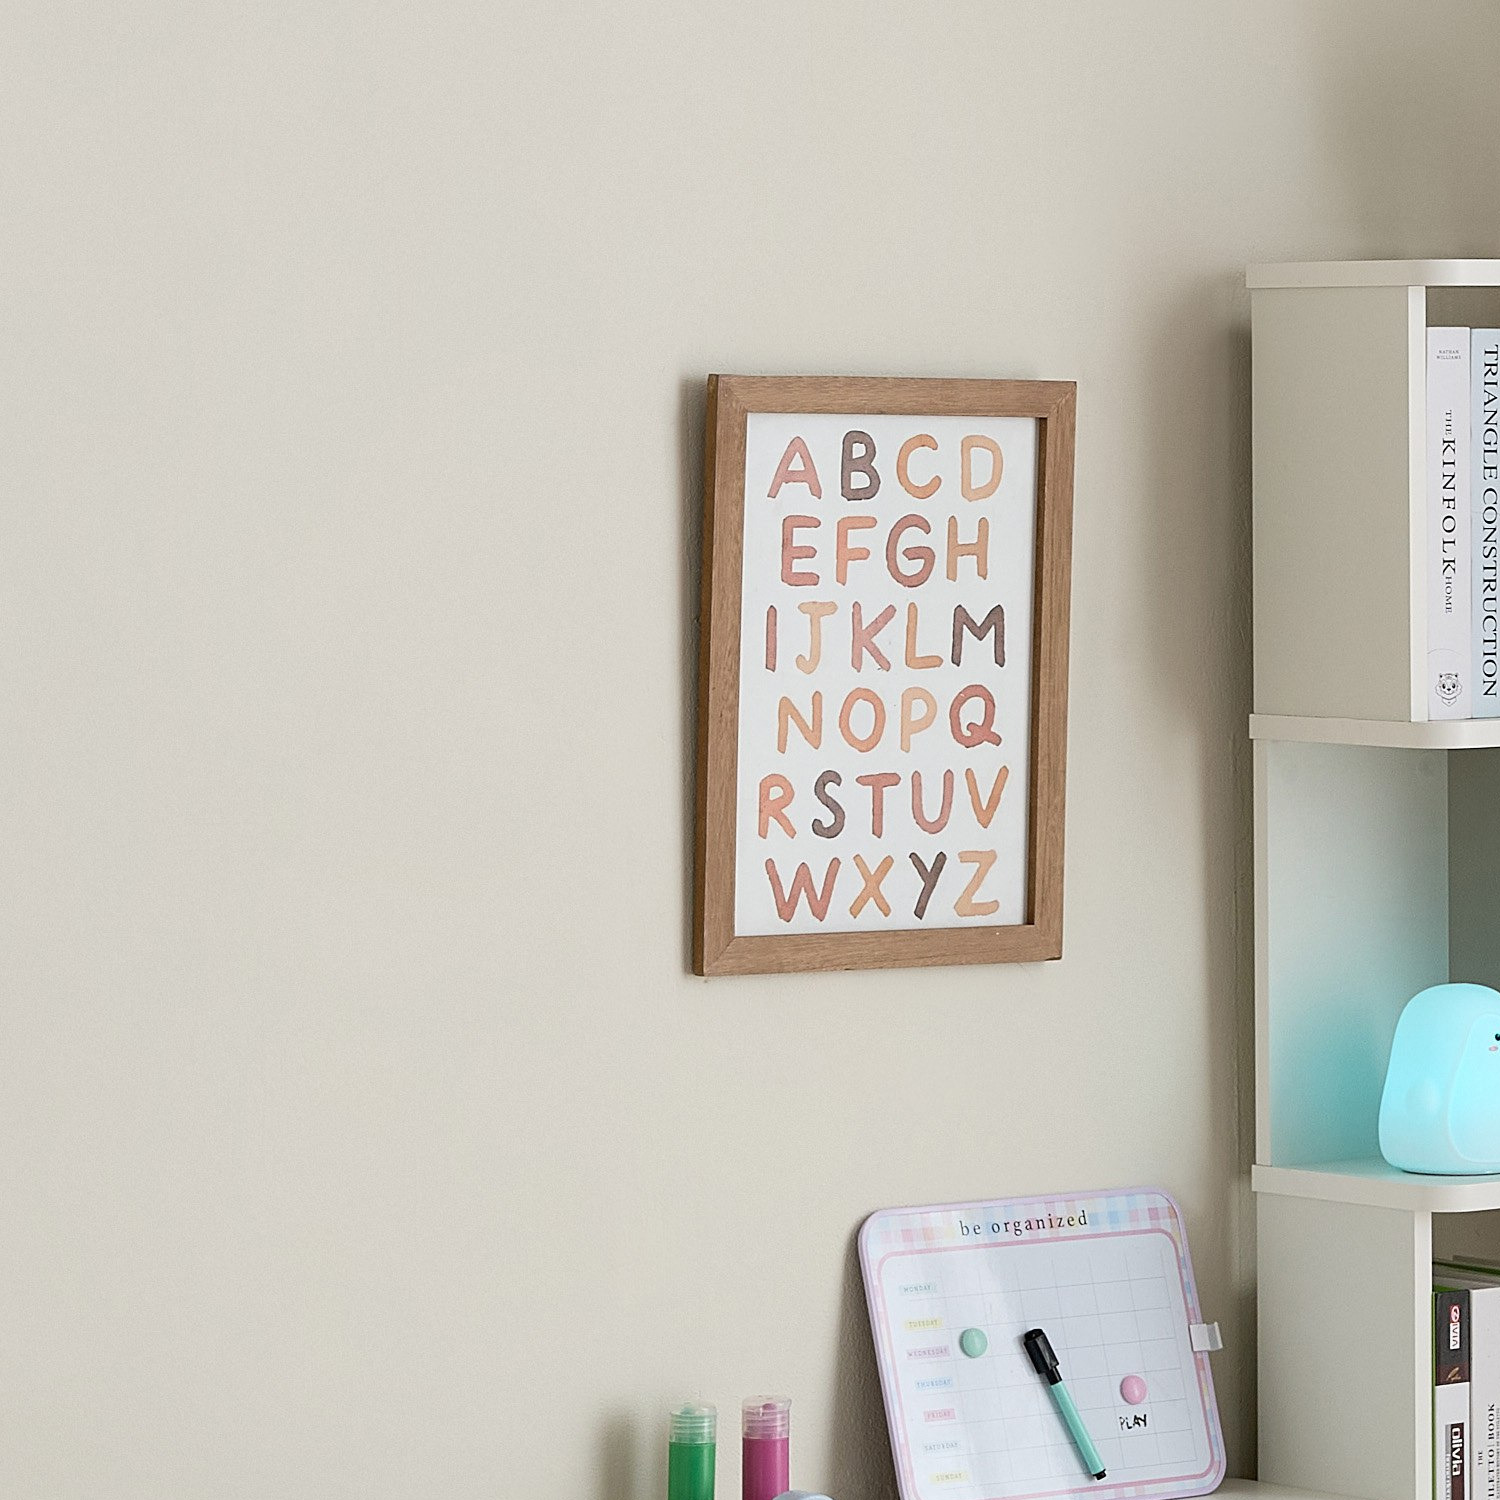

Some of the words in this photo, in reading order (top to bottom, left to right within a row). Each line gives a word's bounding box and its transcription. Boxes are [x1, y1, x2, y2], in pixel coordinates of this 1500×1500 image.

[1482, 344, 1499, 481] TRIANGLE
[1441, 437, 1456, 574] KINFOLK
[1445, 576, 1453, 614] HOME
[1482, 487, 1499, 698] CONSTRUCTION
[960, 1220, 981, 1236] be
[991, 1210, 1088, 1236] organized
[1119, 1414, 1148, 1430] PLAY
[1487, 1404, 1495, 1441] BOOK
[1451, 1427, 1462, 1476] olivia
